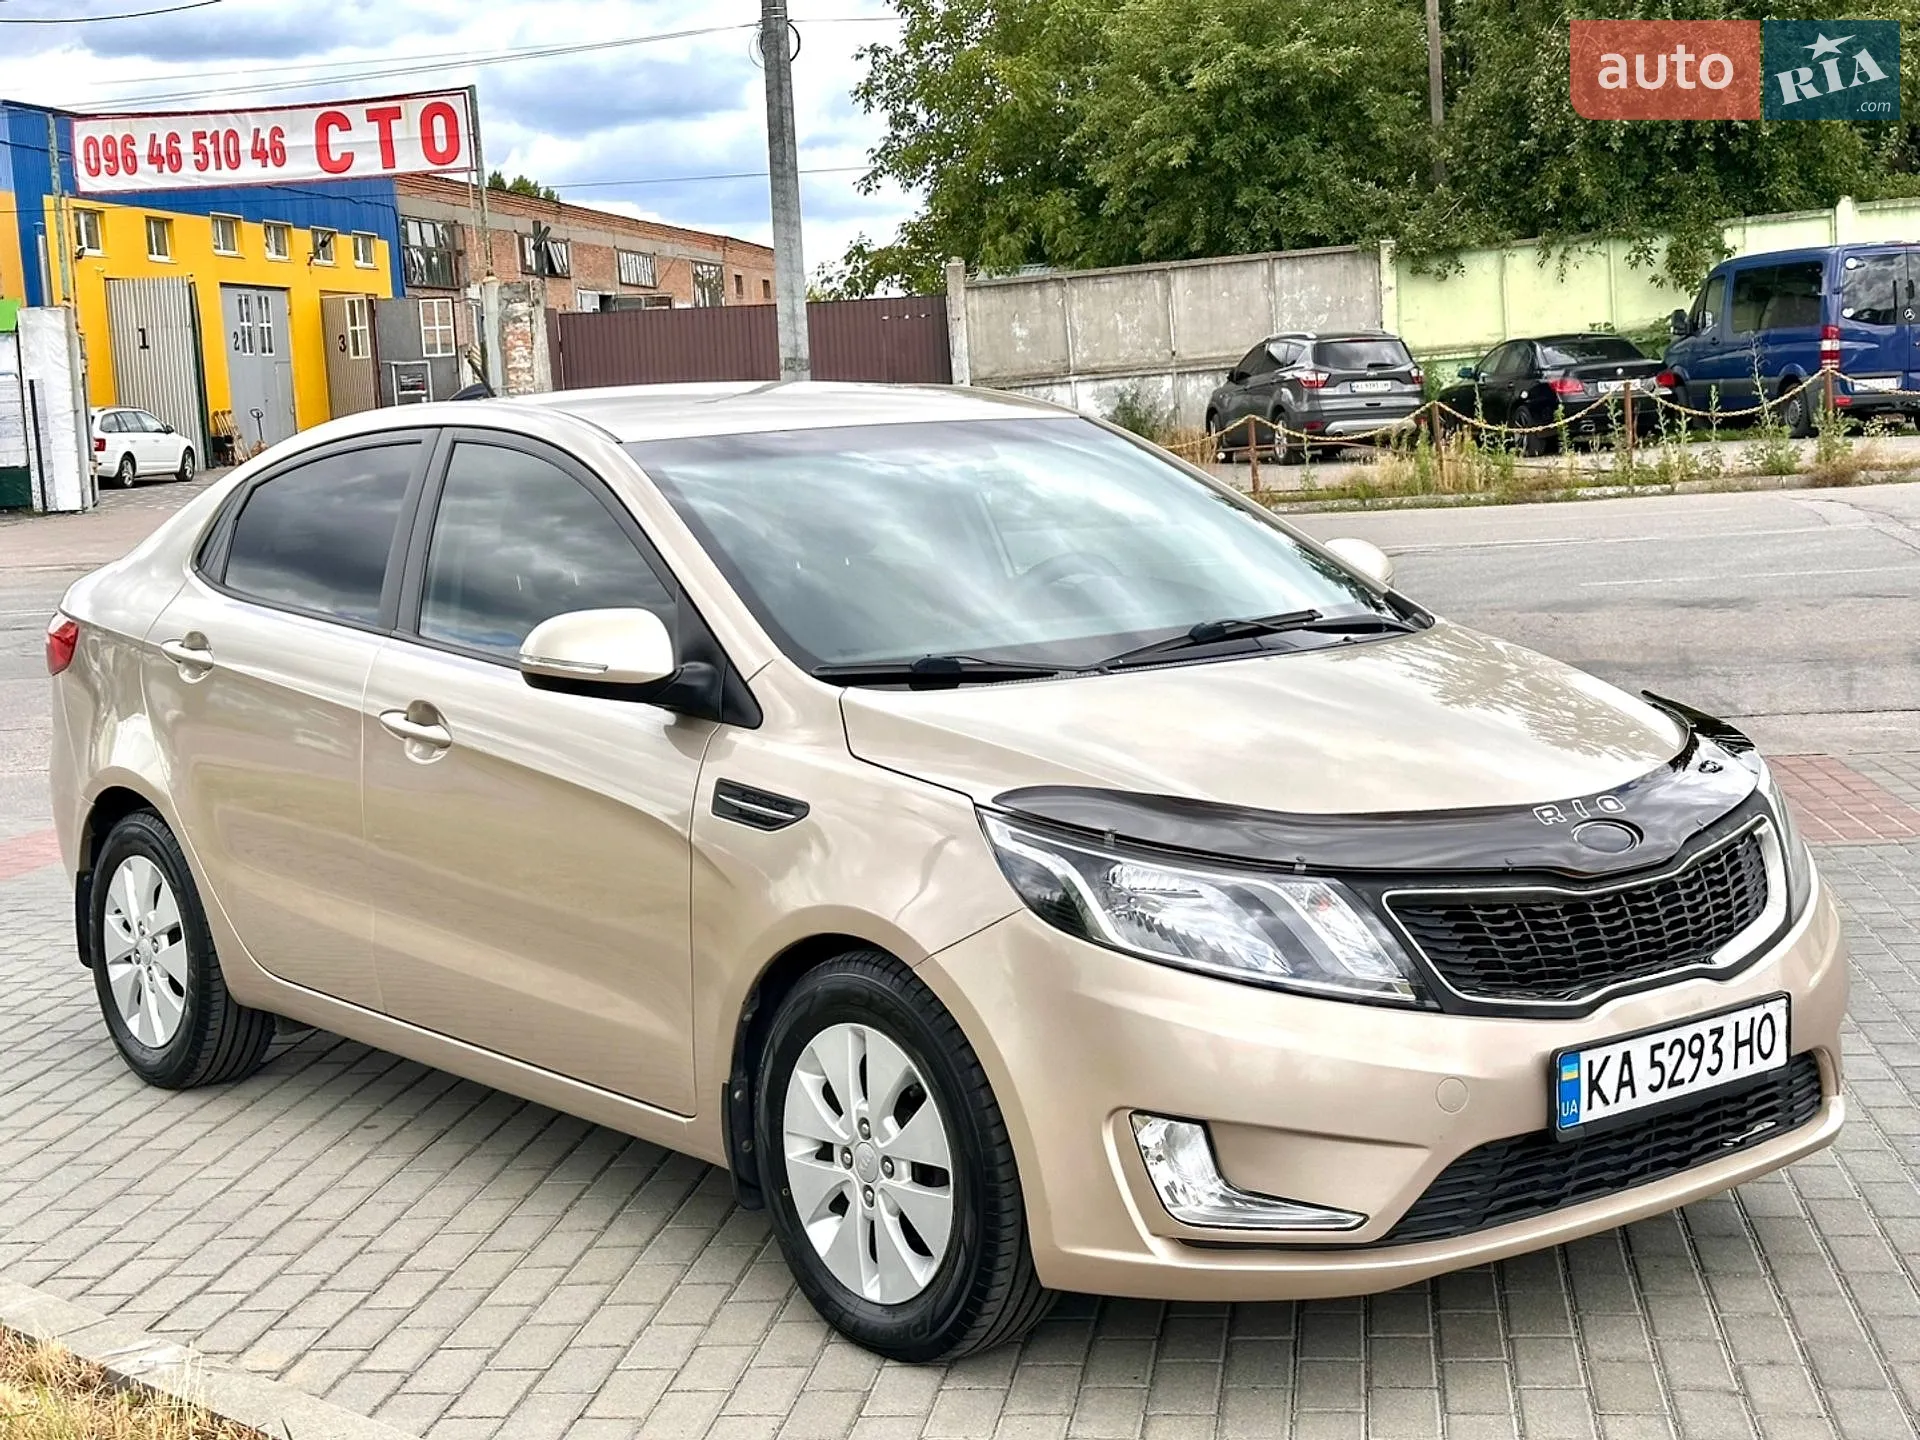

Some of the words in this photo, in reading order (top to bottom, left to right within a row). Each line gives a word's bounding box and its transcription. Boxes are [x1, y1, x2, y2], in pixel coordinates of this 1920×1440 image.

[83, 133, 138, 178] 096
[147, 131, 183, 174] 46
[192, 128, 241, 172] 510
[251, 125, 287, 168] 46
[315, 101, 460, 174] СТО
[138, 328, 150, 350] 1
[233, 331, 240, 351] 2
[338, 334, 347, 352] 3
[1532, 795, 1626, 826] RIO
[1587, 1050, 1637, 1111] KA
[1647, 1026, 1724, 1093] 5293
[1733, 1012, 1776, 1070] HO
[1561, 1100, 1578, 1118] UA
